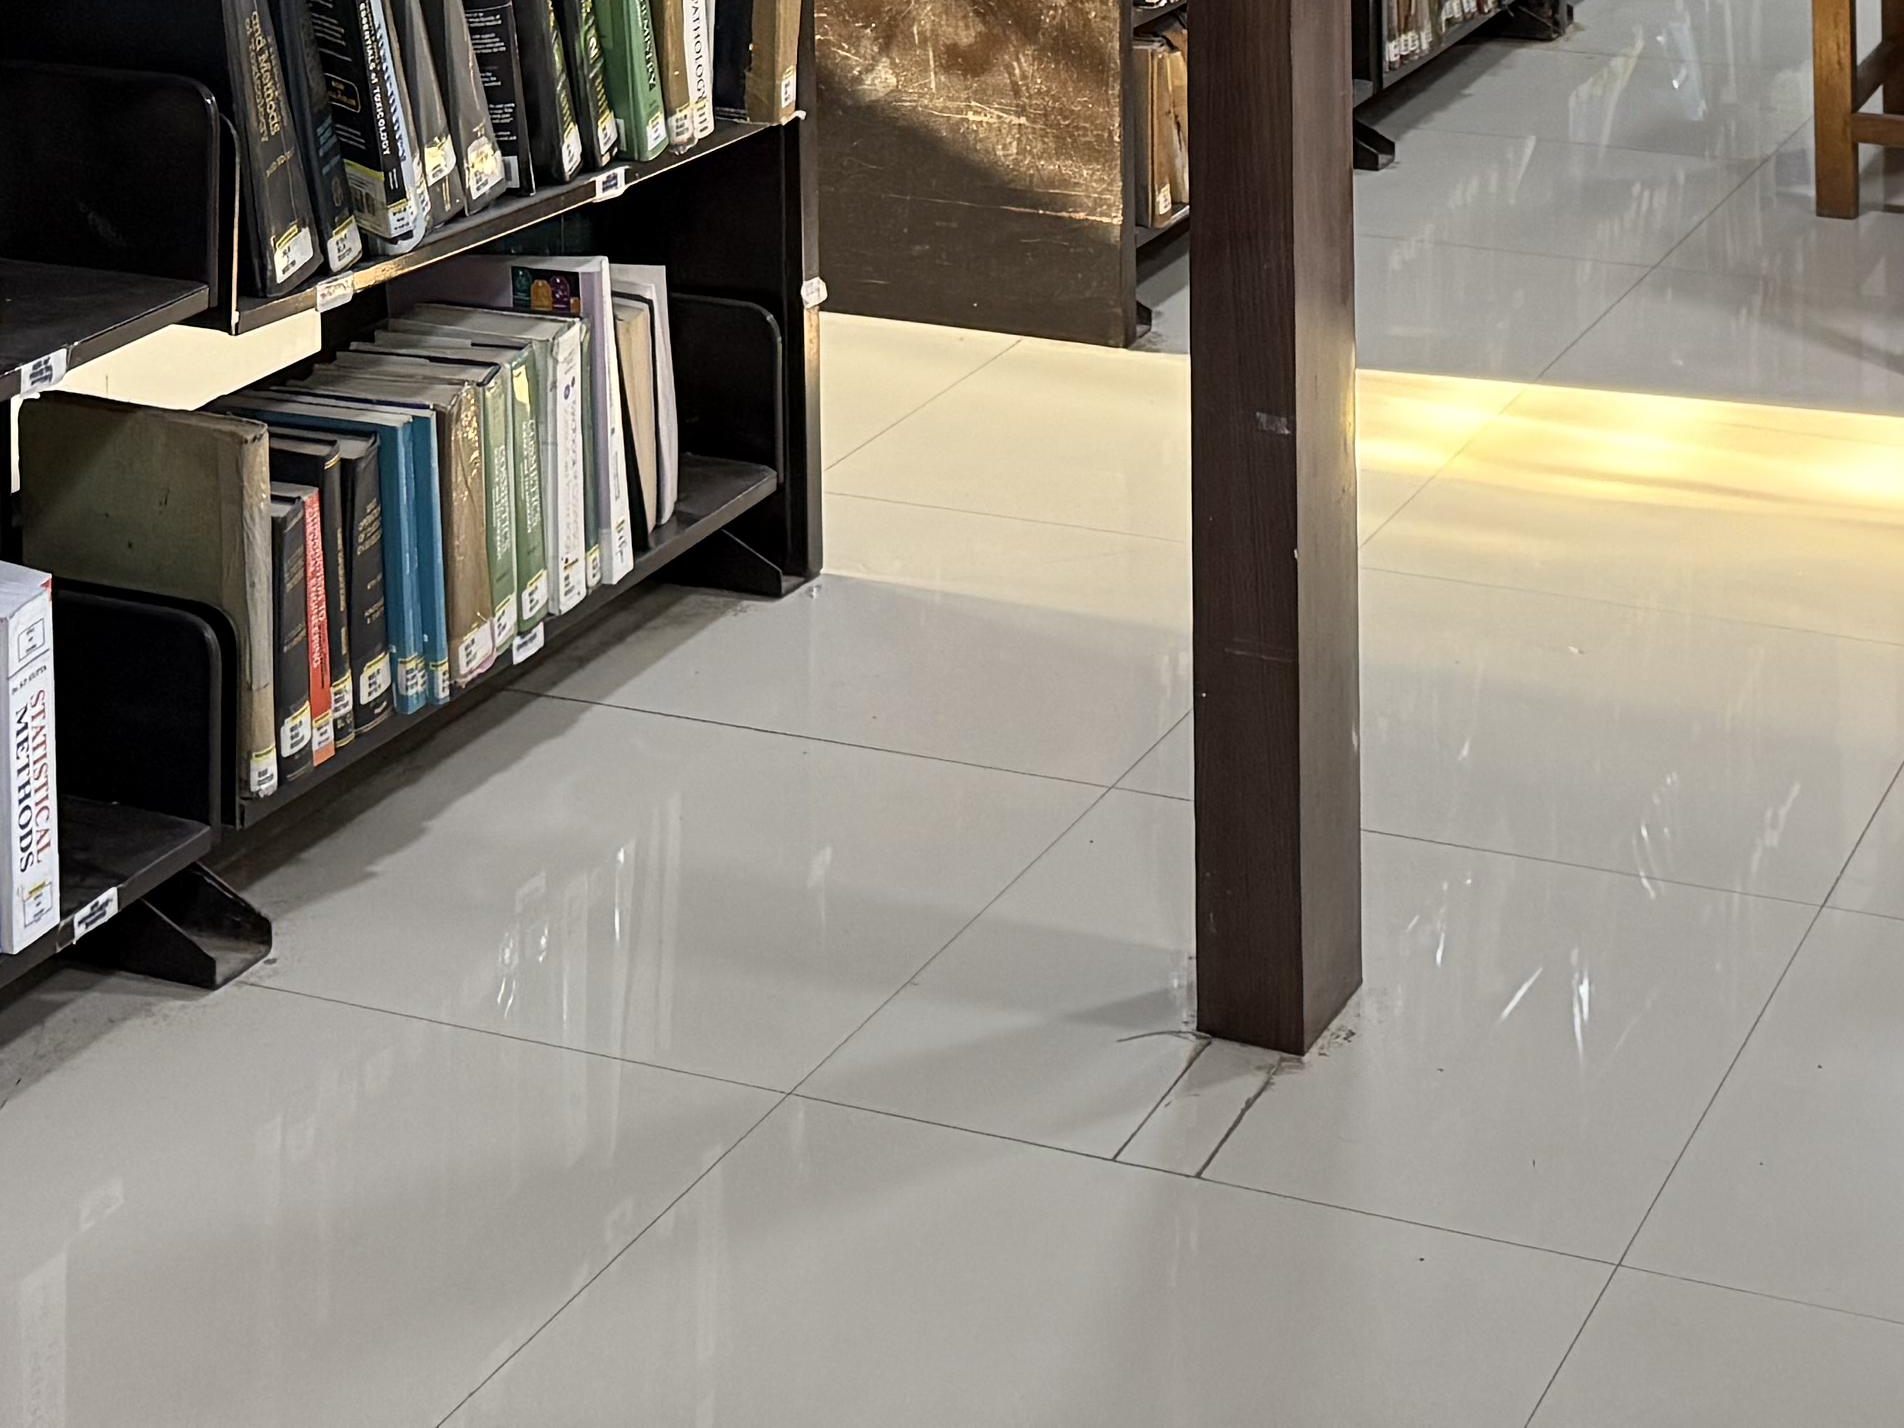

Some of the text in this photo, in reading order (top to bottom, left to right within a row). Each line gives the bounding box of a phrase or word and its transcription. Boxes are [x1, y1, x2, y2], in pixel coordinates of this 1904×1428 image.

[372, 83, 392, 157] TOXICOLOGY
[13, 704, 36, 874] METHODS
[27, 688, 53, 864] STATISTICAL
